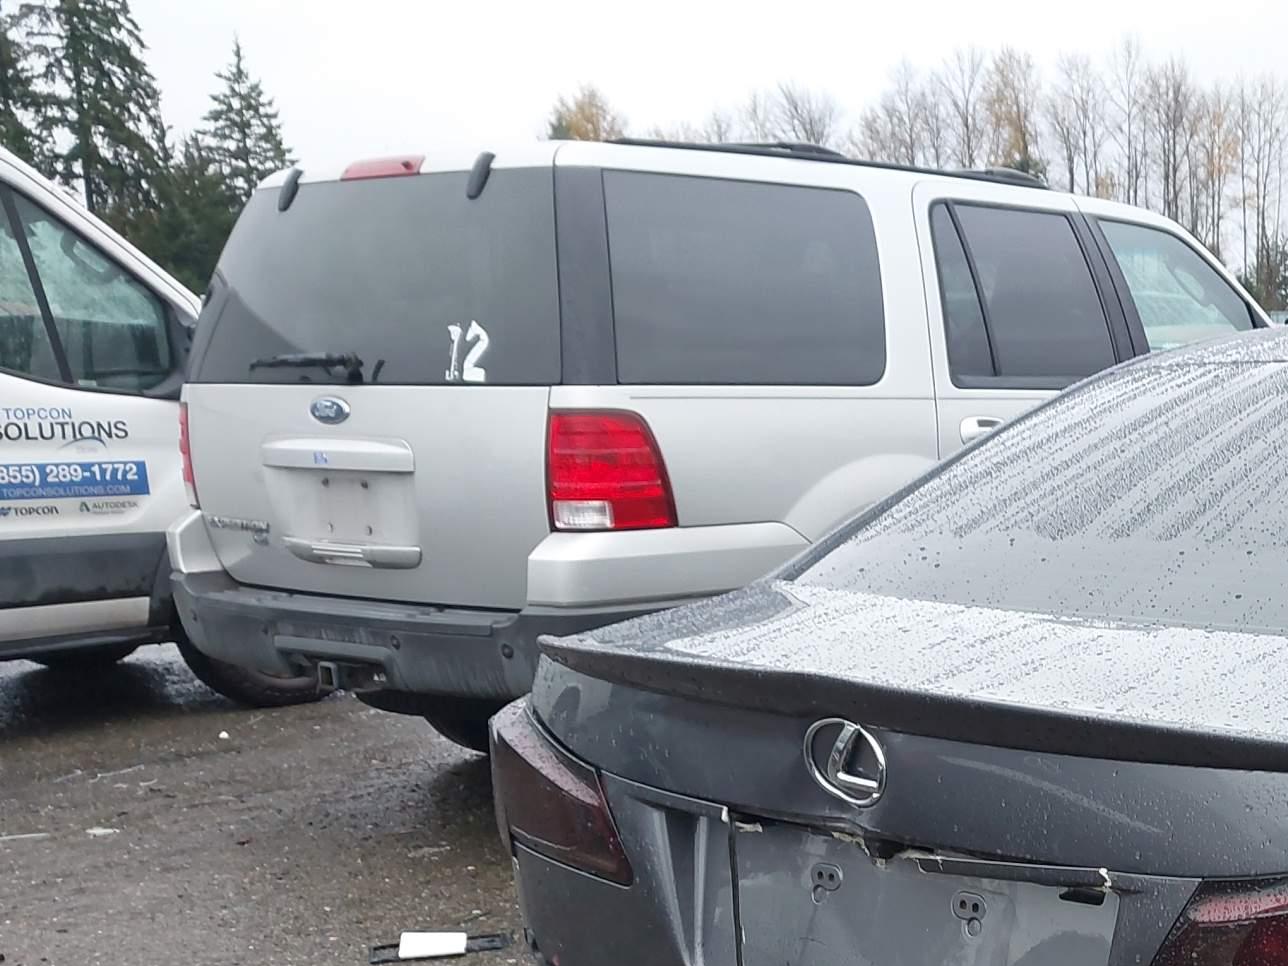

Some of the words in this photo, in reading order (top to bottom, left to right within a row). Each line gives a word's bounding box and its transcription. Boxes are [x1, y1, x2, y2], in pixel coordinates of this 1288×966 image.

[445, 319, 490, 382] 12
[2, 407, 73, 421] TOPCON
[0, 421, 129, 441] OLUTIONS
[46, 463, 138, 483] 289-1772
[14, 505, 60, 517] TOPCON
